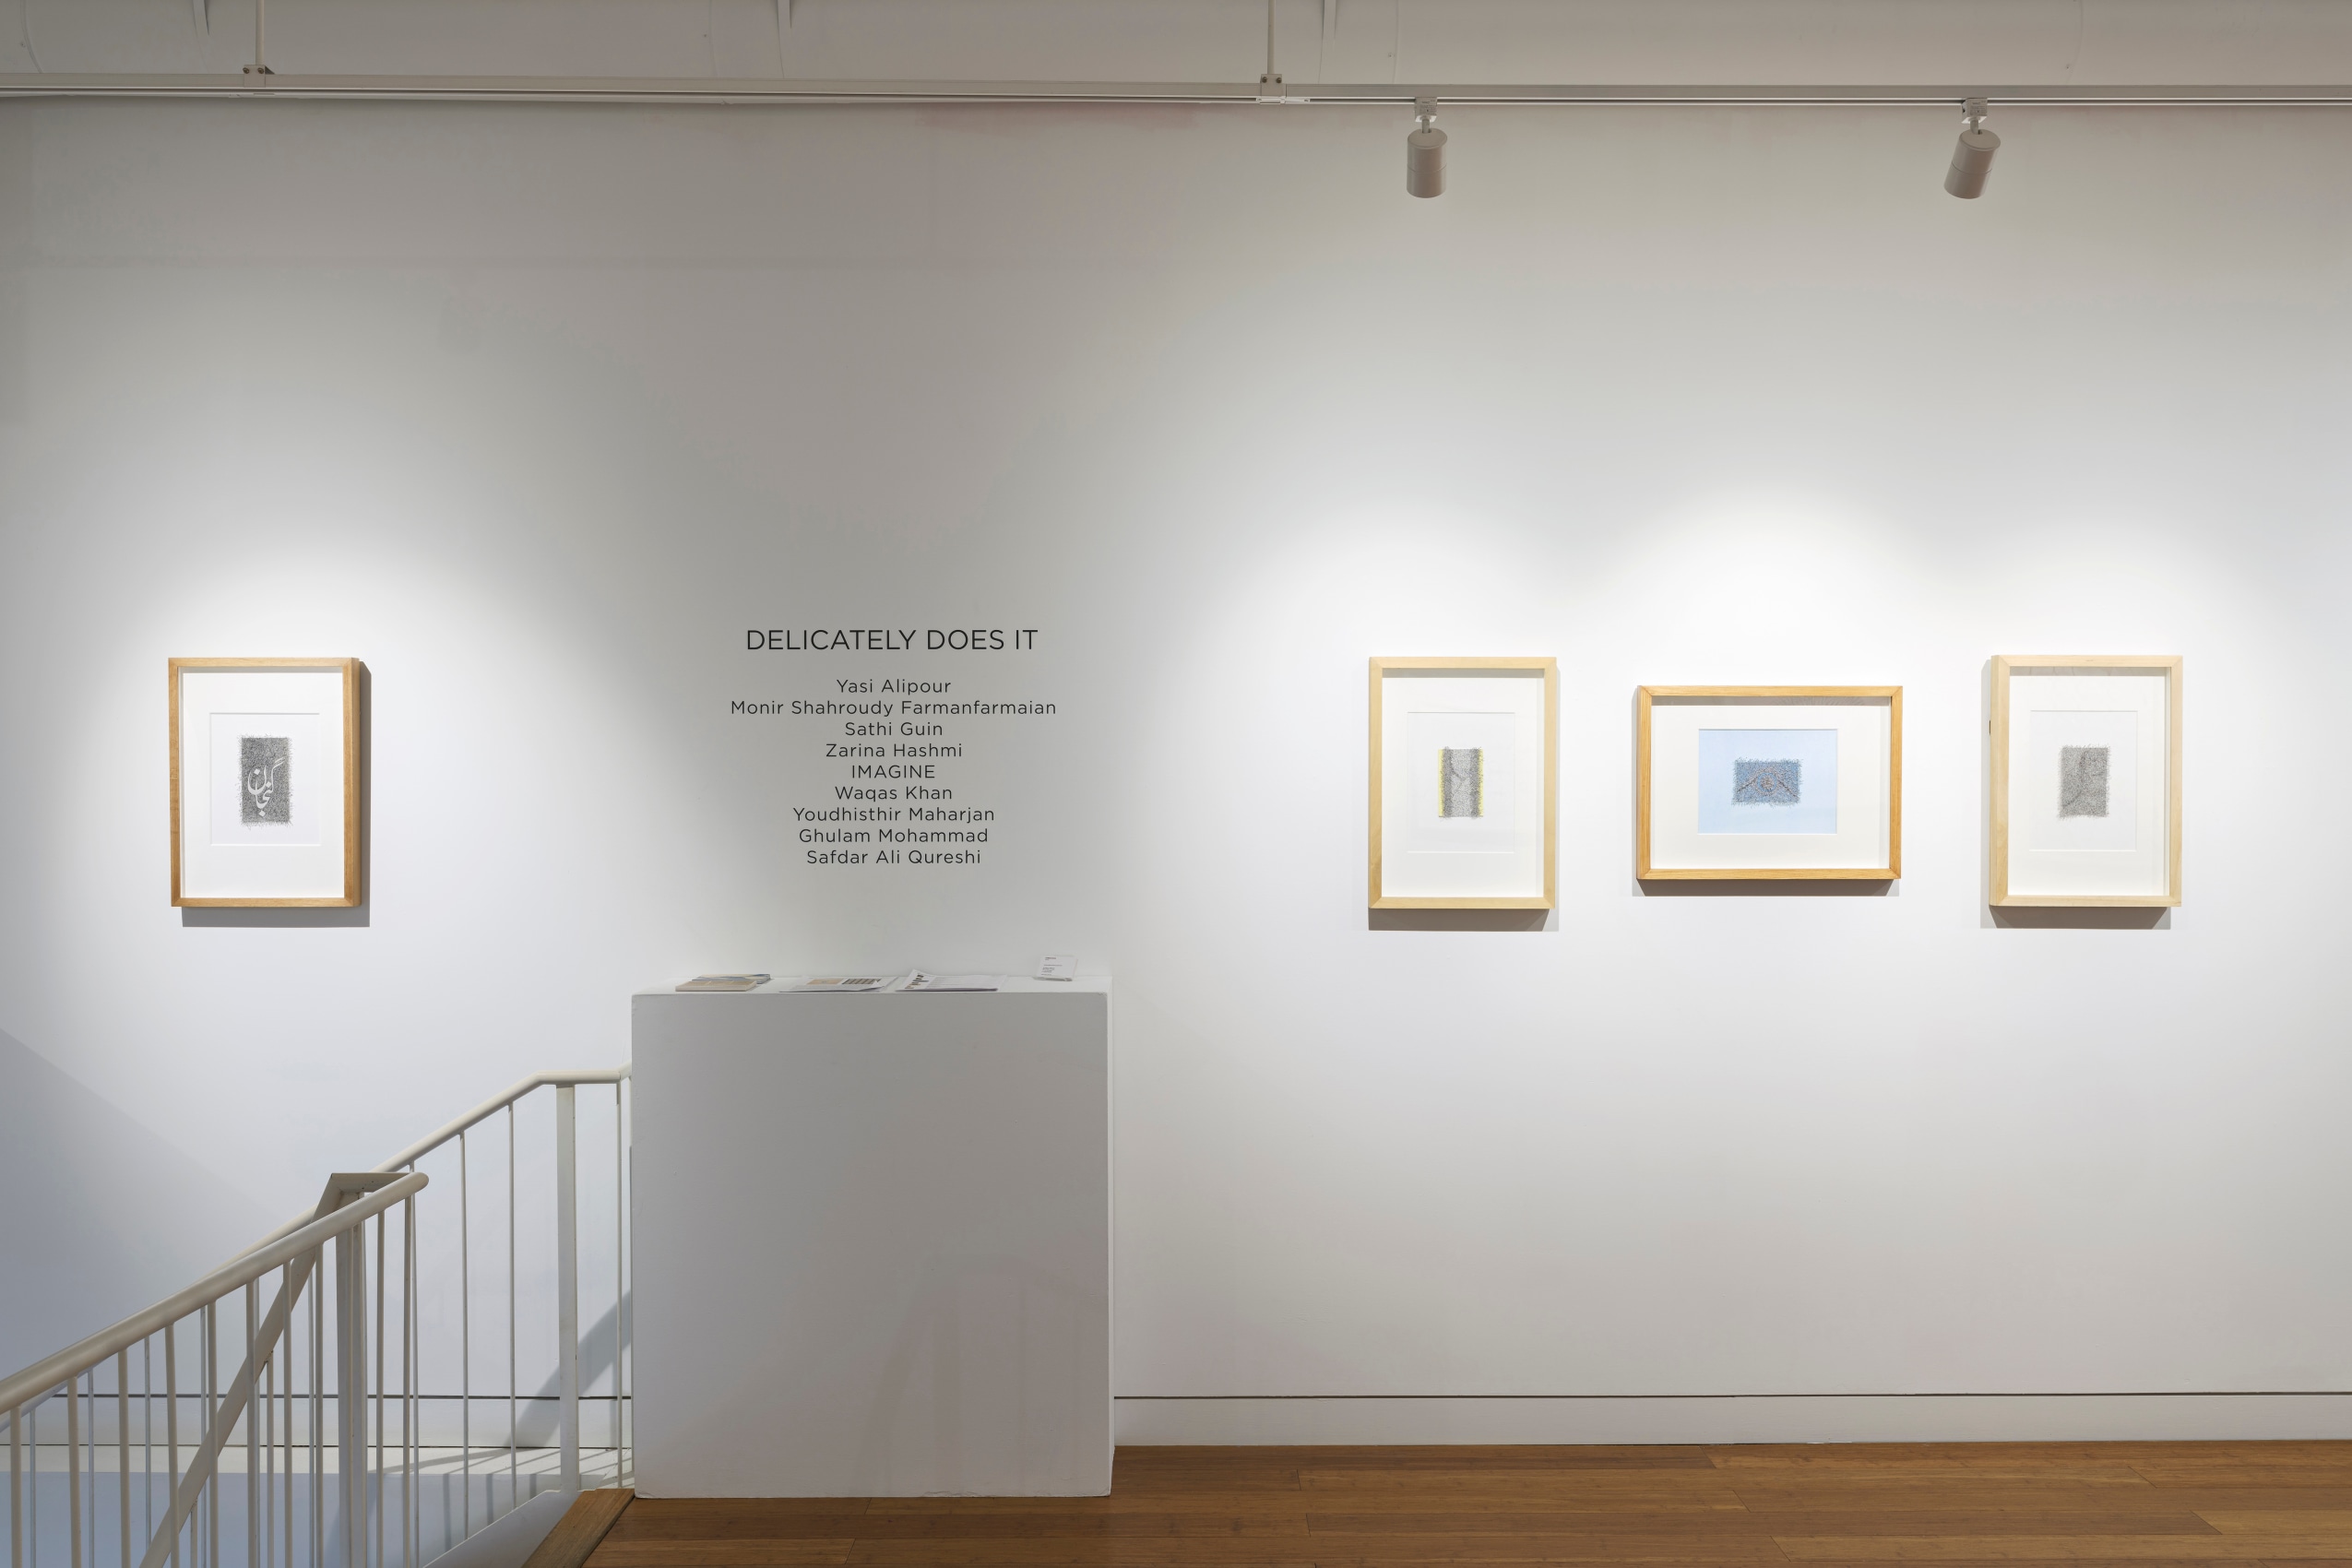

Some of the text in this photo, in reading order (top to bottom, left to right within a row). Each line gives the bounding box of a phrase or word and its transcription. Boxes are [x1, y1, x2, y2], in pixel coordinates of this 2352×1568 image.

[747, 630, 1038, 650] DELICATELY DOES IT
[837, 679, 951, 695] Yasi Alipour
[731, 700, 1055, 717] Monir Shahroudy Farmanfarmaian
[845, 722, 943, 736] Sathi Guin
[826, 743, 962, 757] Zarina Hashmi
[852, 765, 935, 778] IMAGINE
[835, 786, 952, 803] Waqas Khan
[793, 807, 994, 825] Youdhisthir Maharjan
[800, 828, 988, 842] Ghulam Mohammad
[807, 849, 980, 863] Safdar Ali Qureshi
